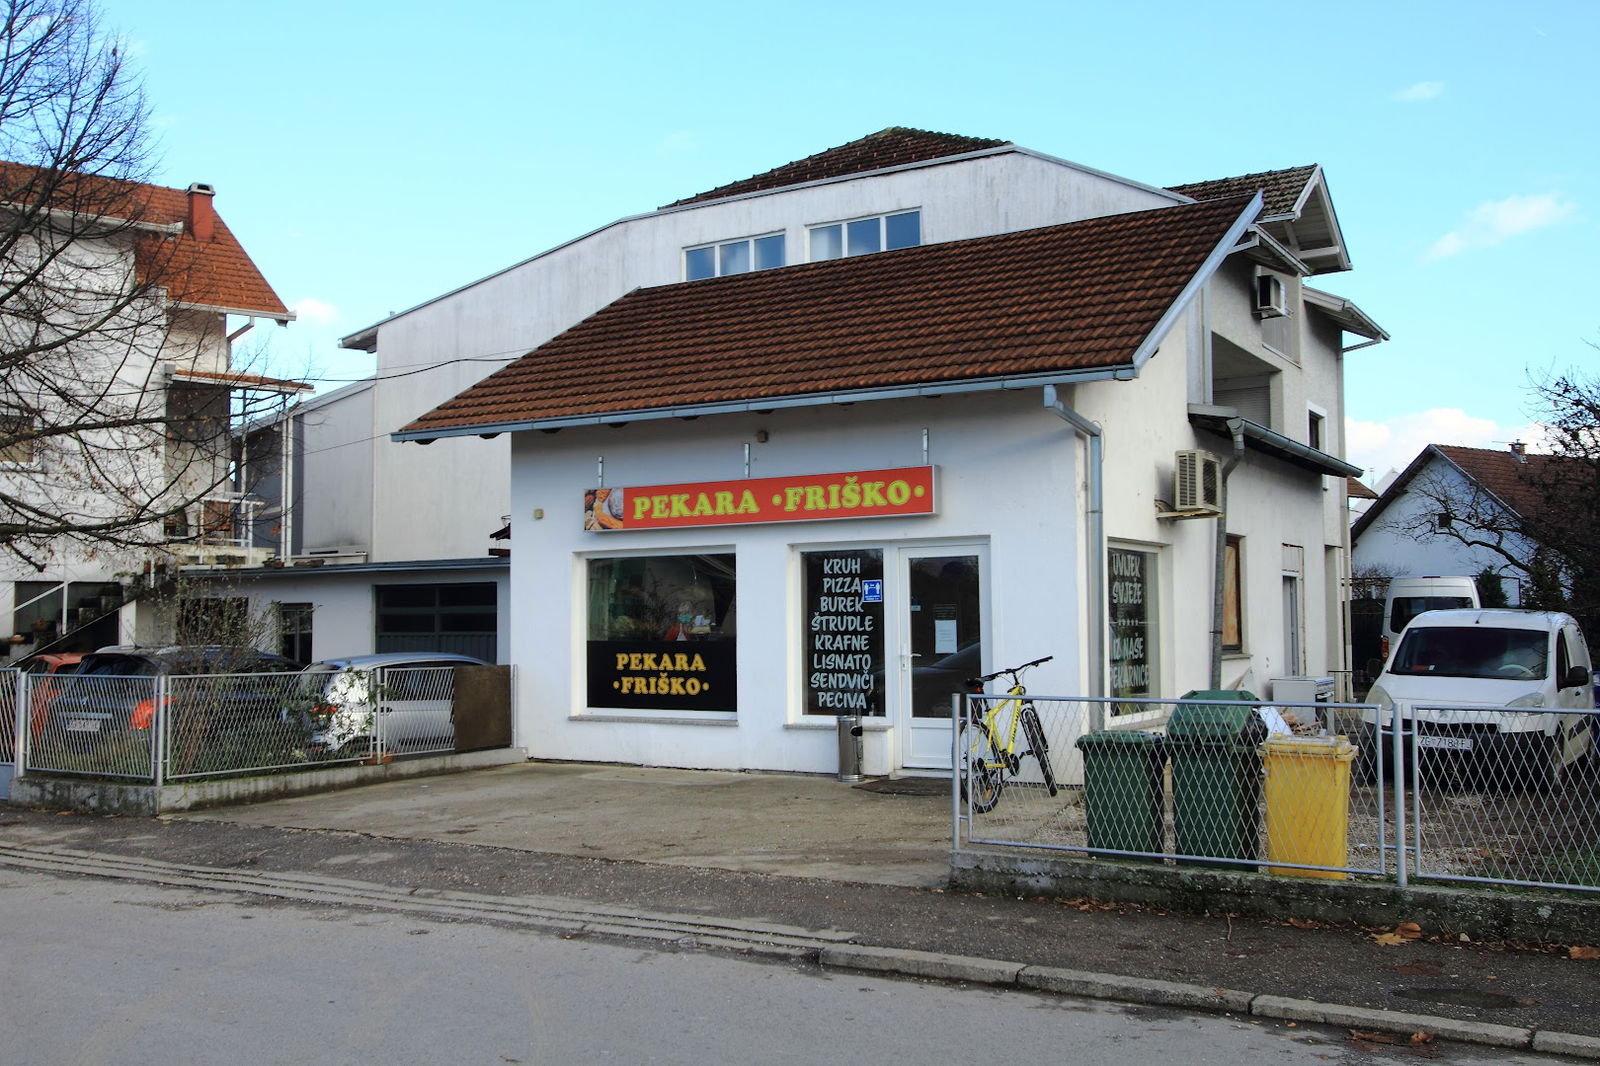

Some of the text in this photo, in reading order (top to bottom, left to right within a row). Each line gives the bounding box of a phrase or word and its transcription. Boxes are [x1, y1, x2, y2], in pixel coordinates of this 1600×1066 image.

[633, 490, 760, 520] PEKARA
[823, 558, 861, 575] KRUH
[1112, 553, 1141, 577] UVIJEK
[823, 577, 862, 593] PIZZA
[1112, 577, 1142, 604] SVJEŽE
[820, 596, 864, 613] BUREK
[811, 612, 874, 632] ŠTRUDLE
[815, 634, 869, 651] KRAFNE
[1123, 632, 1144, 660] NAŠE
[616, 653, 706, 671] PEKARA
[813, 653, 871, 670] LISNATO
[810, 670, 874, 690] SENDVIČI
[818, 691, 867, 709] PECIVA
